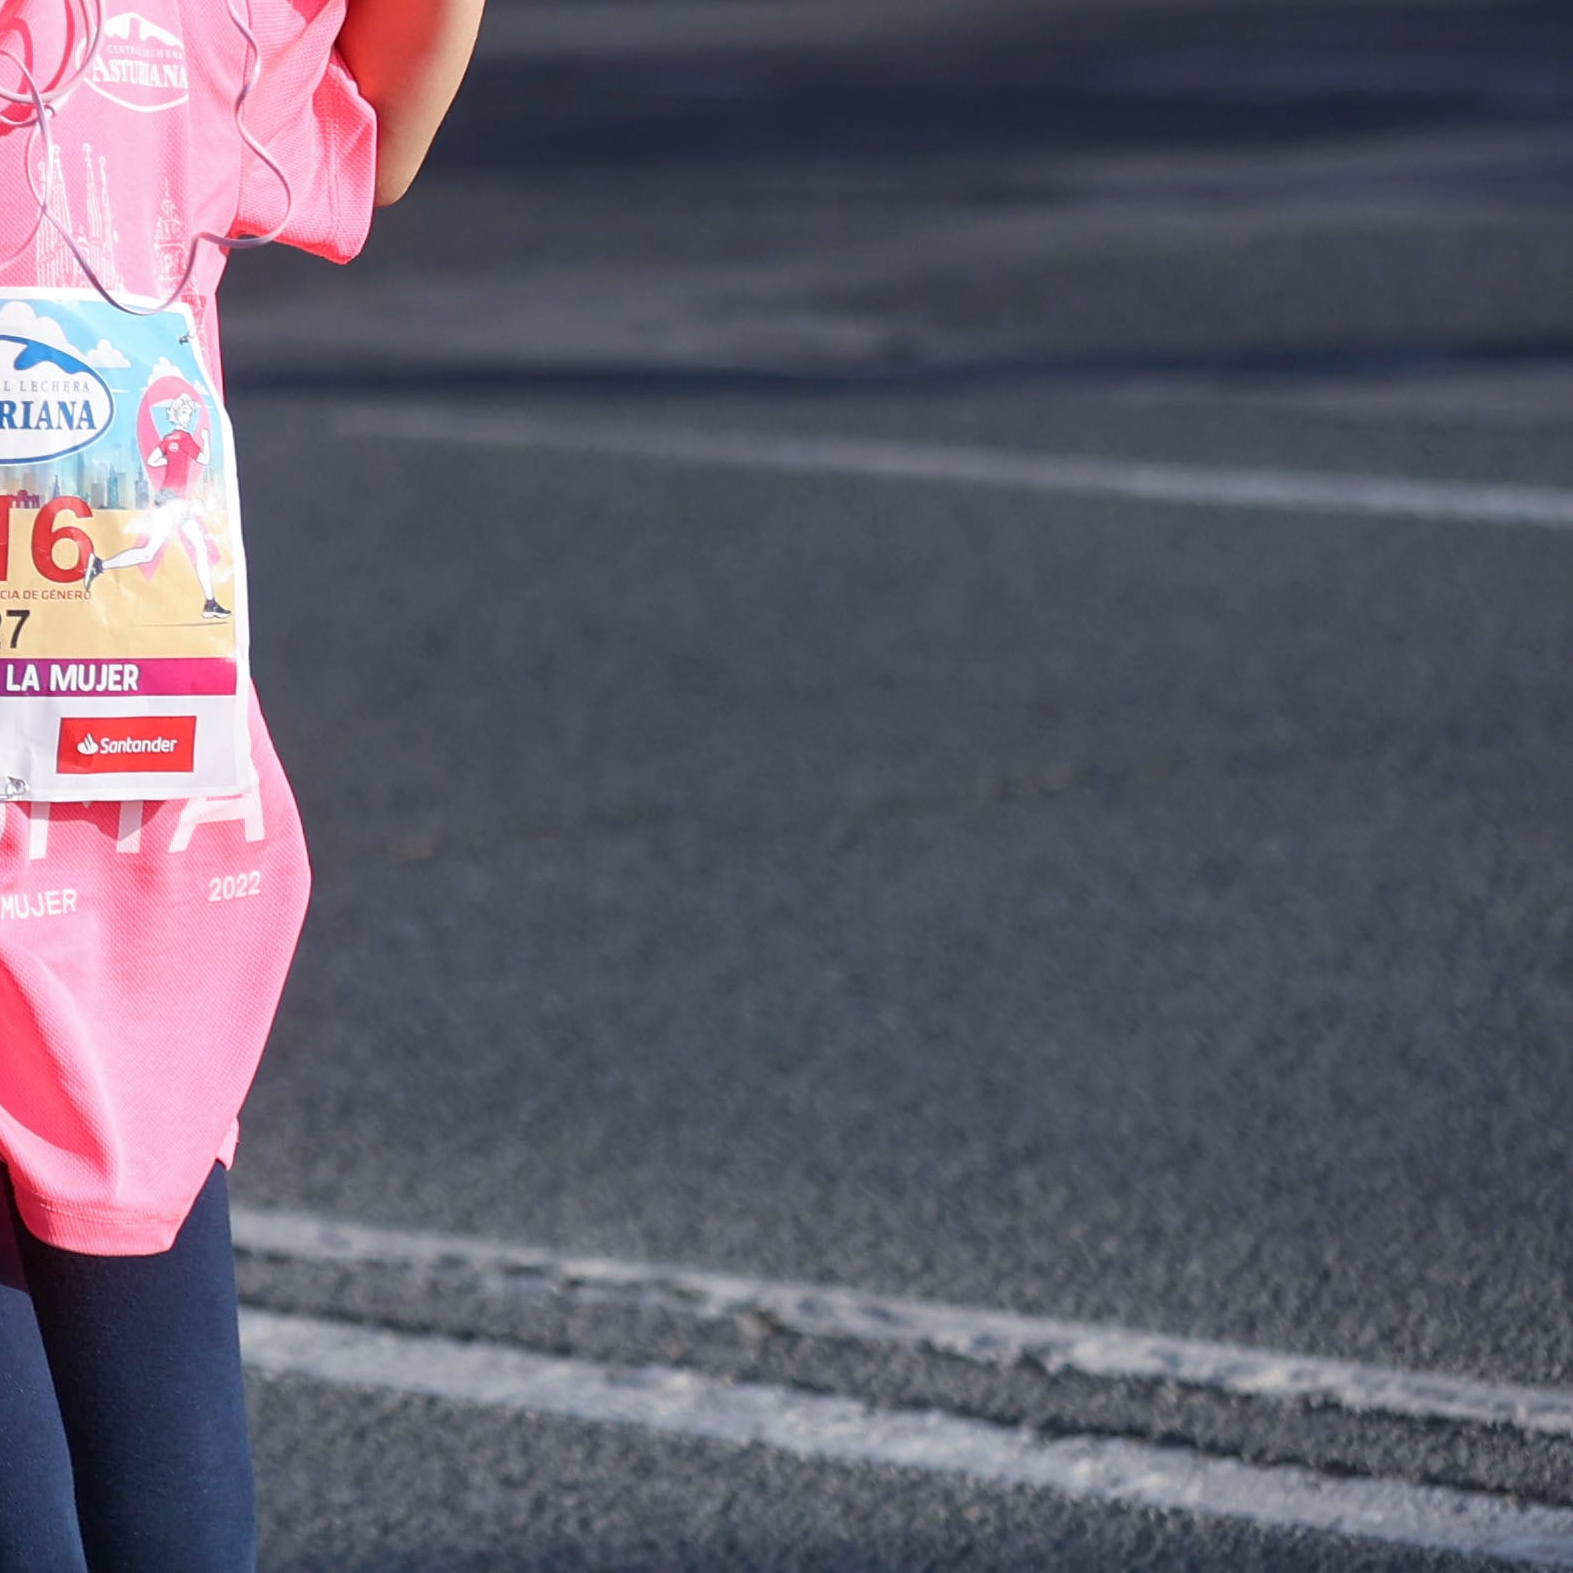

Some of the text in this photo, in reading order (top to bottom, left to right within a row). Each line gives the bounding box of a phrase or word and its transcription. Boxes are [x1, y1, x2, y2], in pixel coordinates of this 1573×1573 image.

[19, 379, 90, 393] LECHERA
[23, 590, 39, 600] DE
[41, 588, 92, 601] GÉNERO
[6, 662, 40, 692] LA
[48, 662, 139, 692] MUJER
[99, 735, 178, 756] Santander
[208, 870, 262, 902] 2022
[0, 888, 78, 921] MUJER
